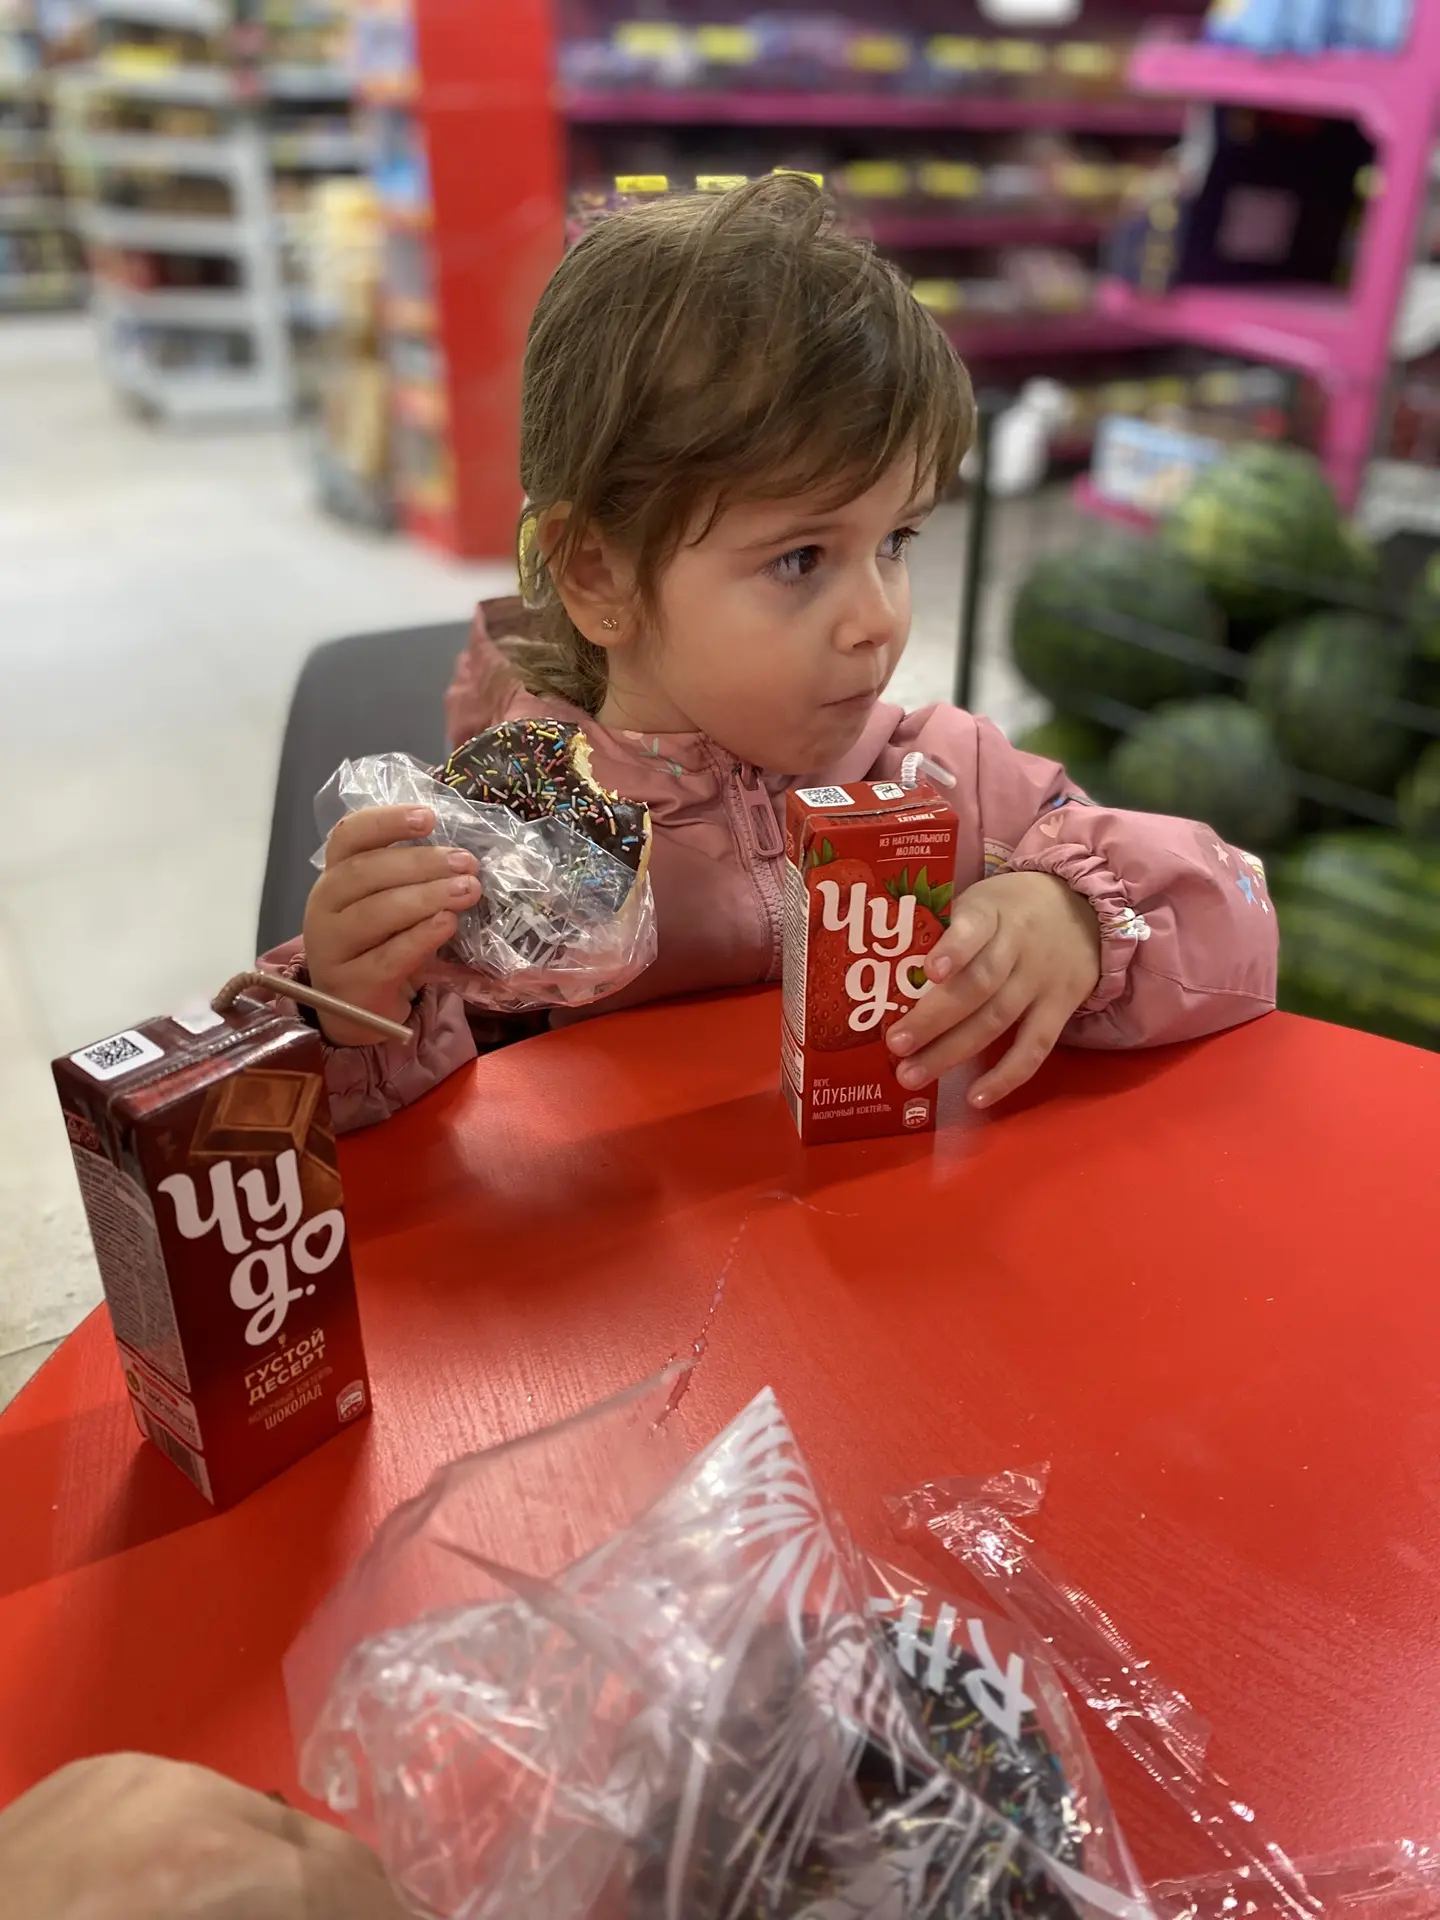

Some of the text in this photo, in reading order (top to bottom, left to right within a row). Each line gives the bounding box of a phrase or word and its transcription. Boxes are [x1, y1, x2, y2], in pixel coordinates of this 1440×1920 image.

[879, 833, 951, 848] ИЗ НАТУРАЛЬНОГО
[895, 846, 931, 856] МОЛОКА
[813, 1077, 831, 1088] ВКУС
[812, 1083, 883, 1106] КЛУБНИКА
[812, 1106, 855, 1120] МОЛОЧНЫЙ
[855, 1103, 892, 1116] КОКТЕЙЛЬ
[244, 1327, 326, 1390] ГУСТОЙ
[248, 1344, 326, 1407] ДЕСЕРТ
[264, 1384, 323, 1431] ШОКОЛАД
